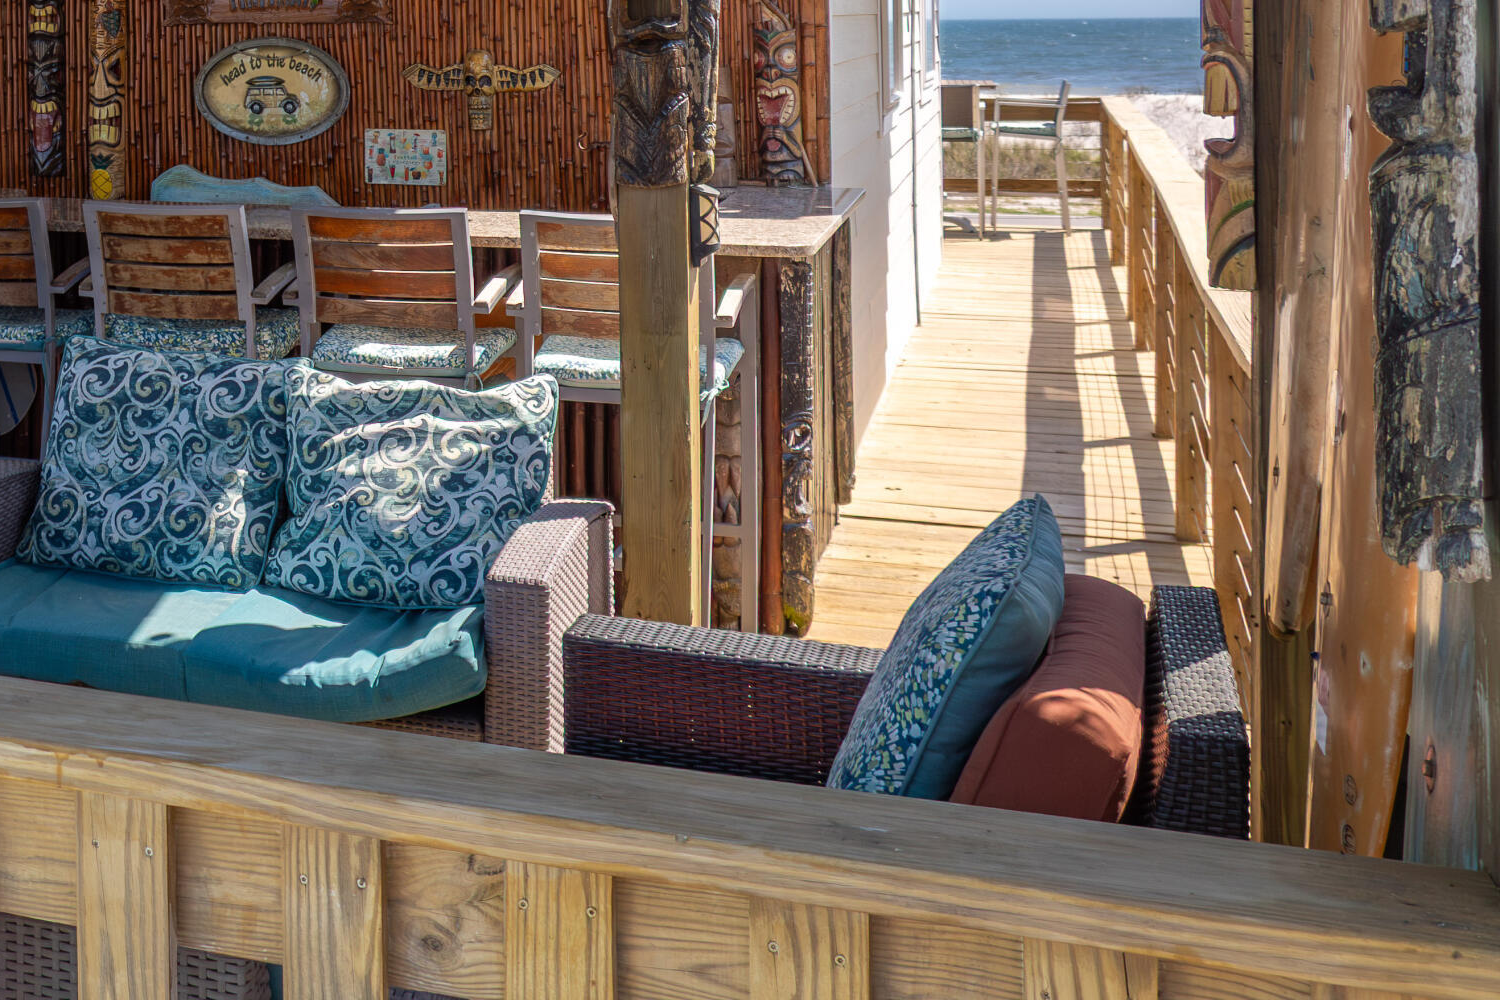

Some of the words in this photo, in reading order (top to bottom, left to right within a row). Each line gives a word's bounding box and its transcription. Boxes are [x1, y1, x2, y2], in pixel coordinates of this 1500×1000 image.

[220, 59, 247, 86] head
[249, 56, 262, 70] to
[266, 53, 286, 68] the
[289, 56, 322, 82] beach
